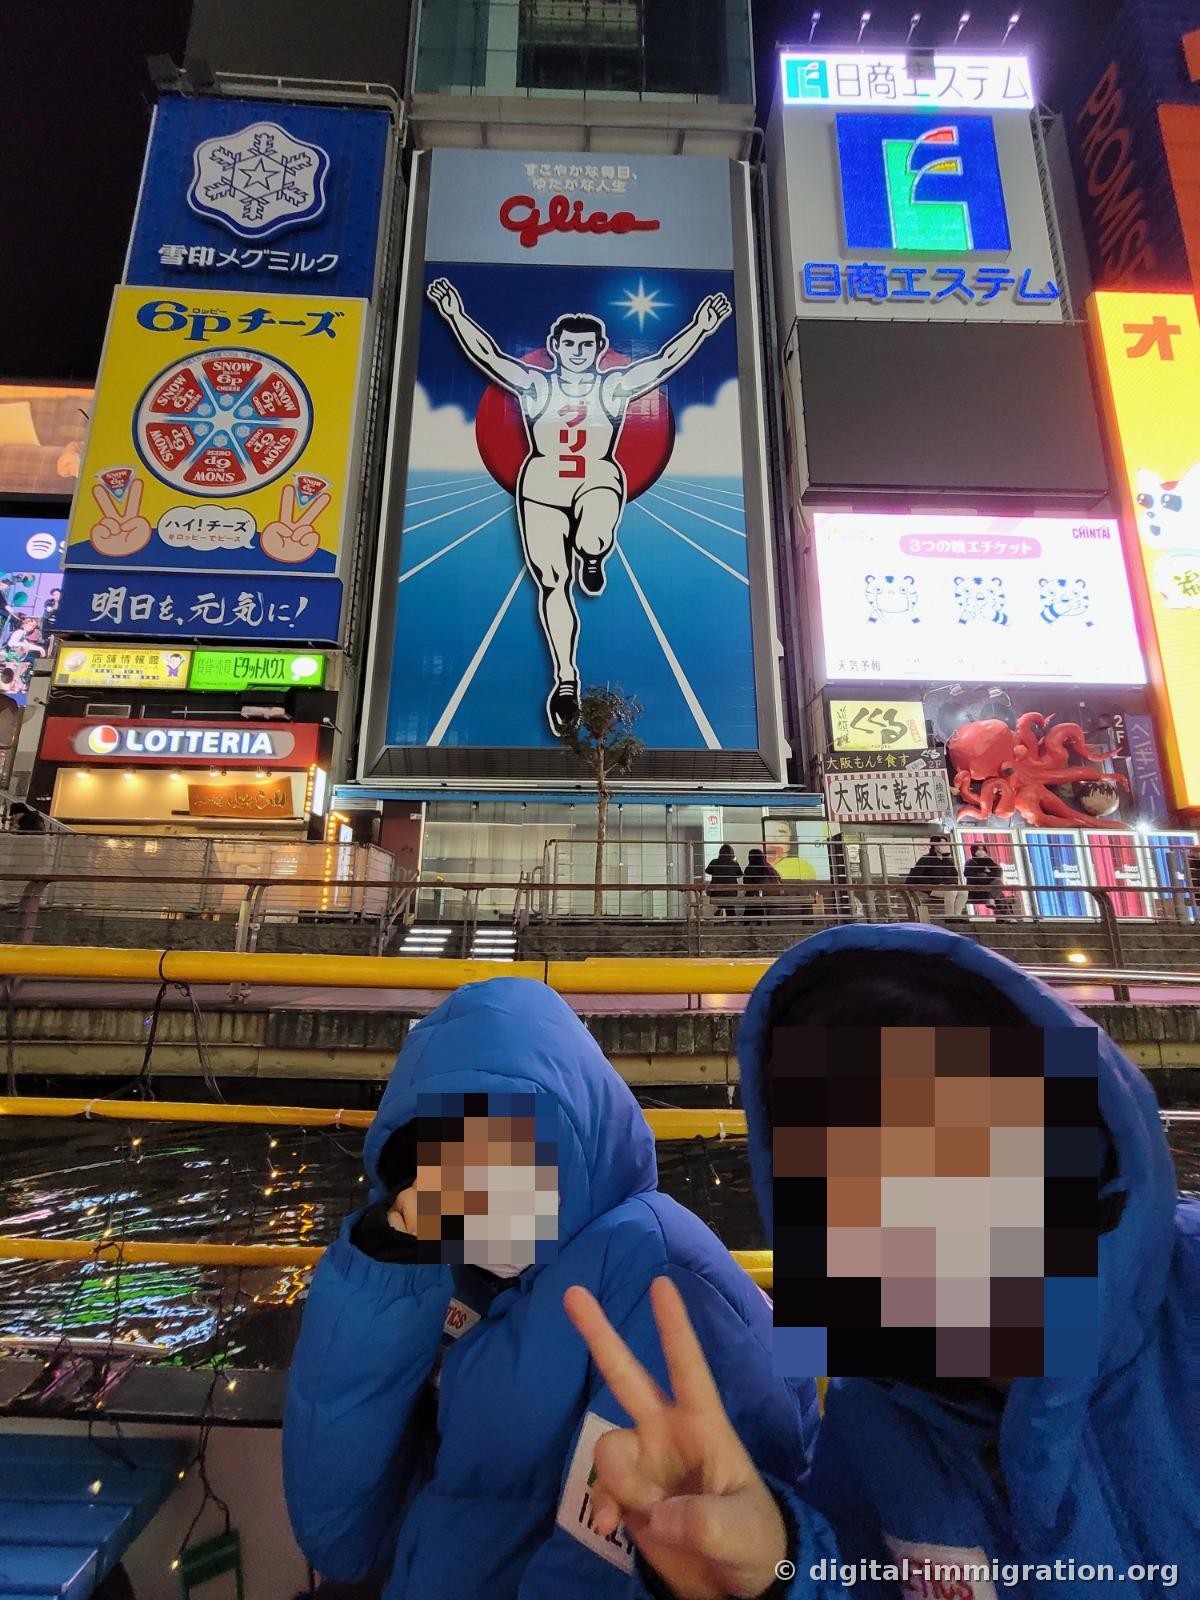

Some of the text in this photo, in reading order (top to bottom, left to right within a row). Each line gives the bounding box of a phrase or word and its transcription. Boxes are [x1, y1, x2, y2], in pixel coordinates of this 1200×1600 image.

[524, 163, 637, 179] すこやかな毎日、
[533, 179, 626, 193] ゆたかな人生
[158, 244, 339, 274] 雪印メグミルク
[804, 263, 1060, 301] 日商エステム
[1123, 316, 1181, 361] オ
[212, 362, 253, 372] SNOW
[156, 374, 187, 406] SNOW
[272, 380, 297, 412] SNOW
[150, 430, 174, 462] SNOW
[261, 434, 291, 468] SNOW
[559, 399, 588, 478] グリコ
[193, 471, 236, 482] SNOW
[168, 534, 241, 542] #ロッピーでピース
[1072, 526, 1110, 539] CHINTAI
[233, 656, 285, 679] ピタットハウス
[837, 660, 881, 671] 天気予報
[850, 707, 908, 745] くくる
[125, 729, 273, 755] LOTTERIA
[826, 754, 910, 770] 大阪もんを食す
[928, 761, 943, 769] 2F
[834, 779, 932, 812] 大阪に乾杯
